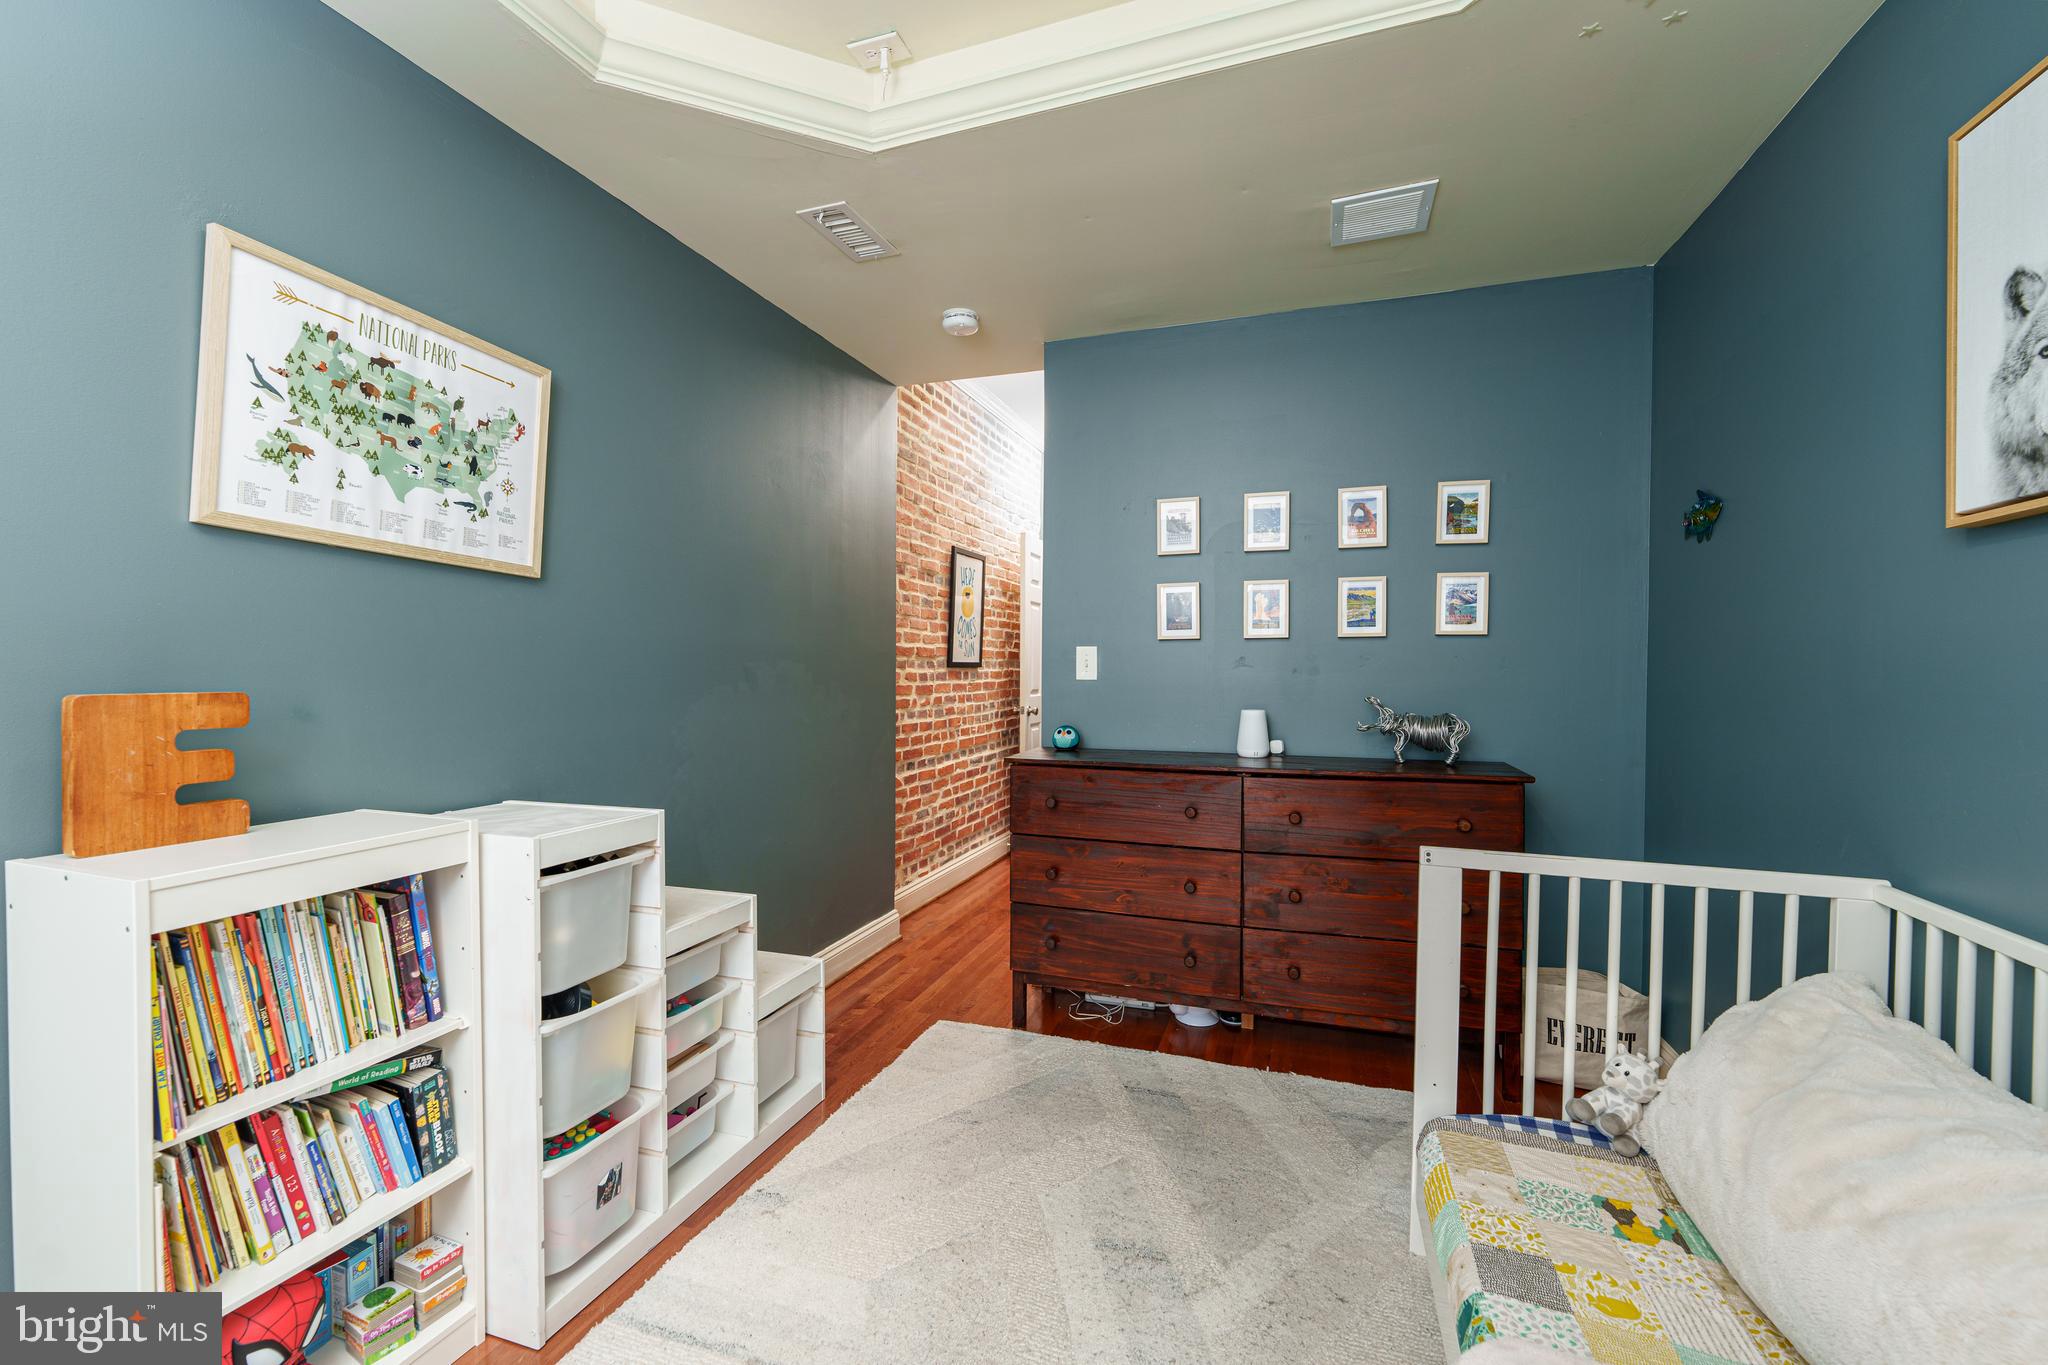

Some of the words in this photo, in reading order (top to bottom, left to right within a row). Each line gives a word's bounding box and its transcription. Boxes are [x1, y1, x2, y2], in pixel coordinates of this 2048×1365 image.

[360, 313, 419, 358] NATIONAL
[423, 340, 457, 372] PARKS
[960, 567, 976, 587] HERE
[957, 616, 976, 640] COMES
[964, 640, 975, 657] SUN
[271, 956, 279, 972] LLAMA
[238, 969, 246, 985] LLAMA
[242, 985, 250, 1001] LLAMA
[281, 973, 289, 989] LLAMA
[431, 997, 442, 1014] MARVEL
[172, 986, 180, 1003] LLAMA
[176, 1004, 184, 1021] LLAMA
[184, 1038, 192, 1054] MAMA
[155, 1041, 163, 1049] A
[155, 1052, 165, 1067] NOT
[409, 1060, 432, 1071] WARS
[413, 1054, 434, 1064] STAR
[157, 1069, 166, 1083] AM
[338, 1074, 359, 1087] World
[361, 1072, 369, 1080] of
[370, 1064, 399, 1078] Reading
[424, 1267, 432, 1276] Up
[433, 1264, 439, 1272] In
[440, 1257, 450, 1268] The
[450, 1250, 462, 1261] Sky
[370, 1330, 379, 1338] On
